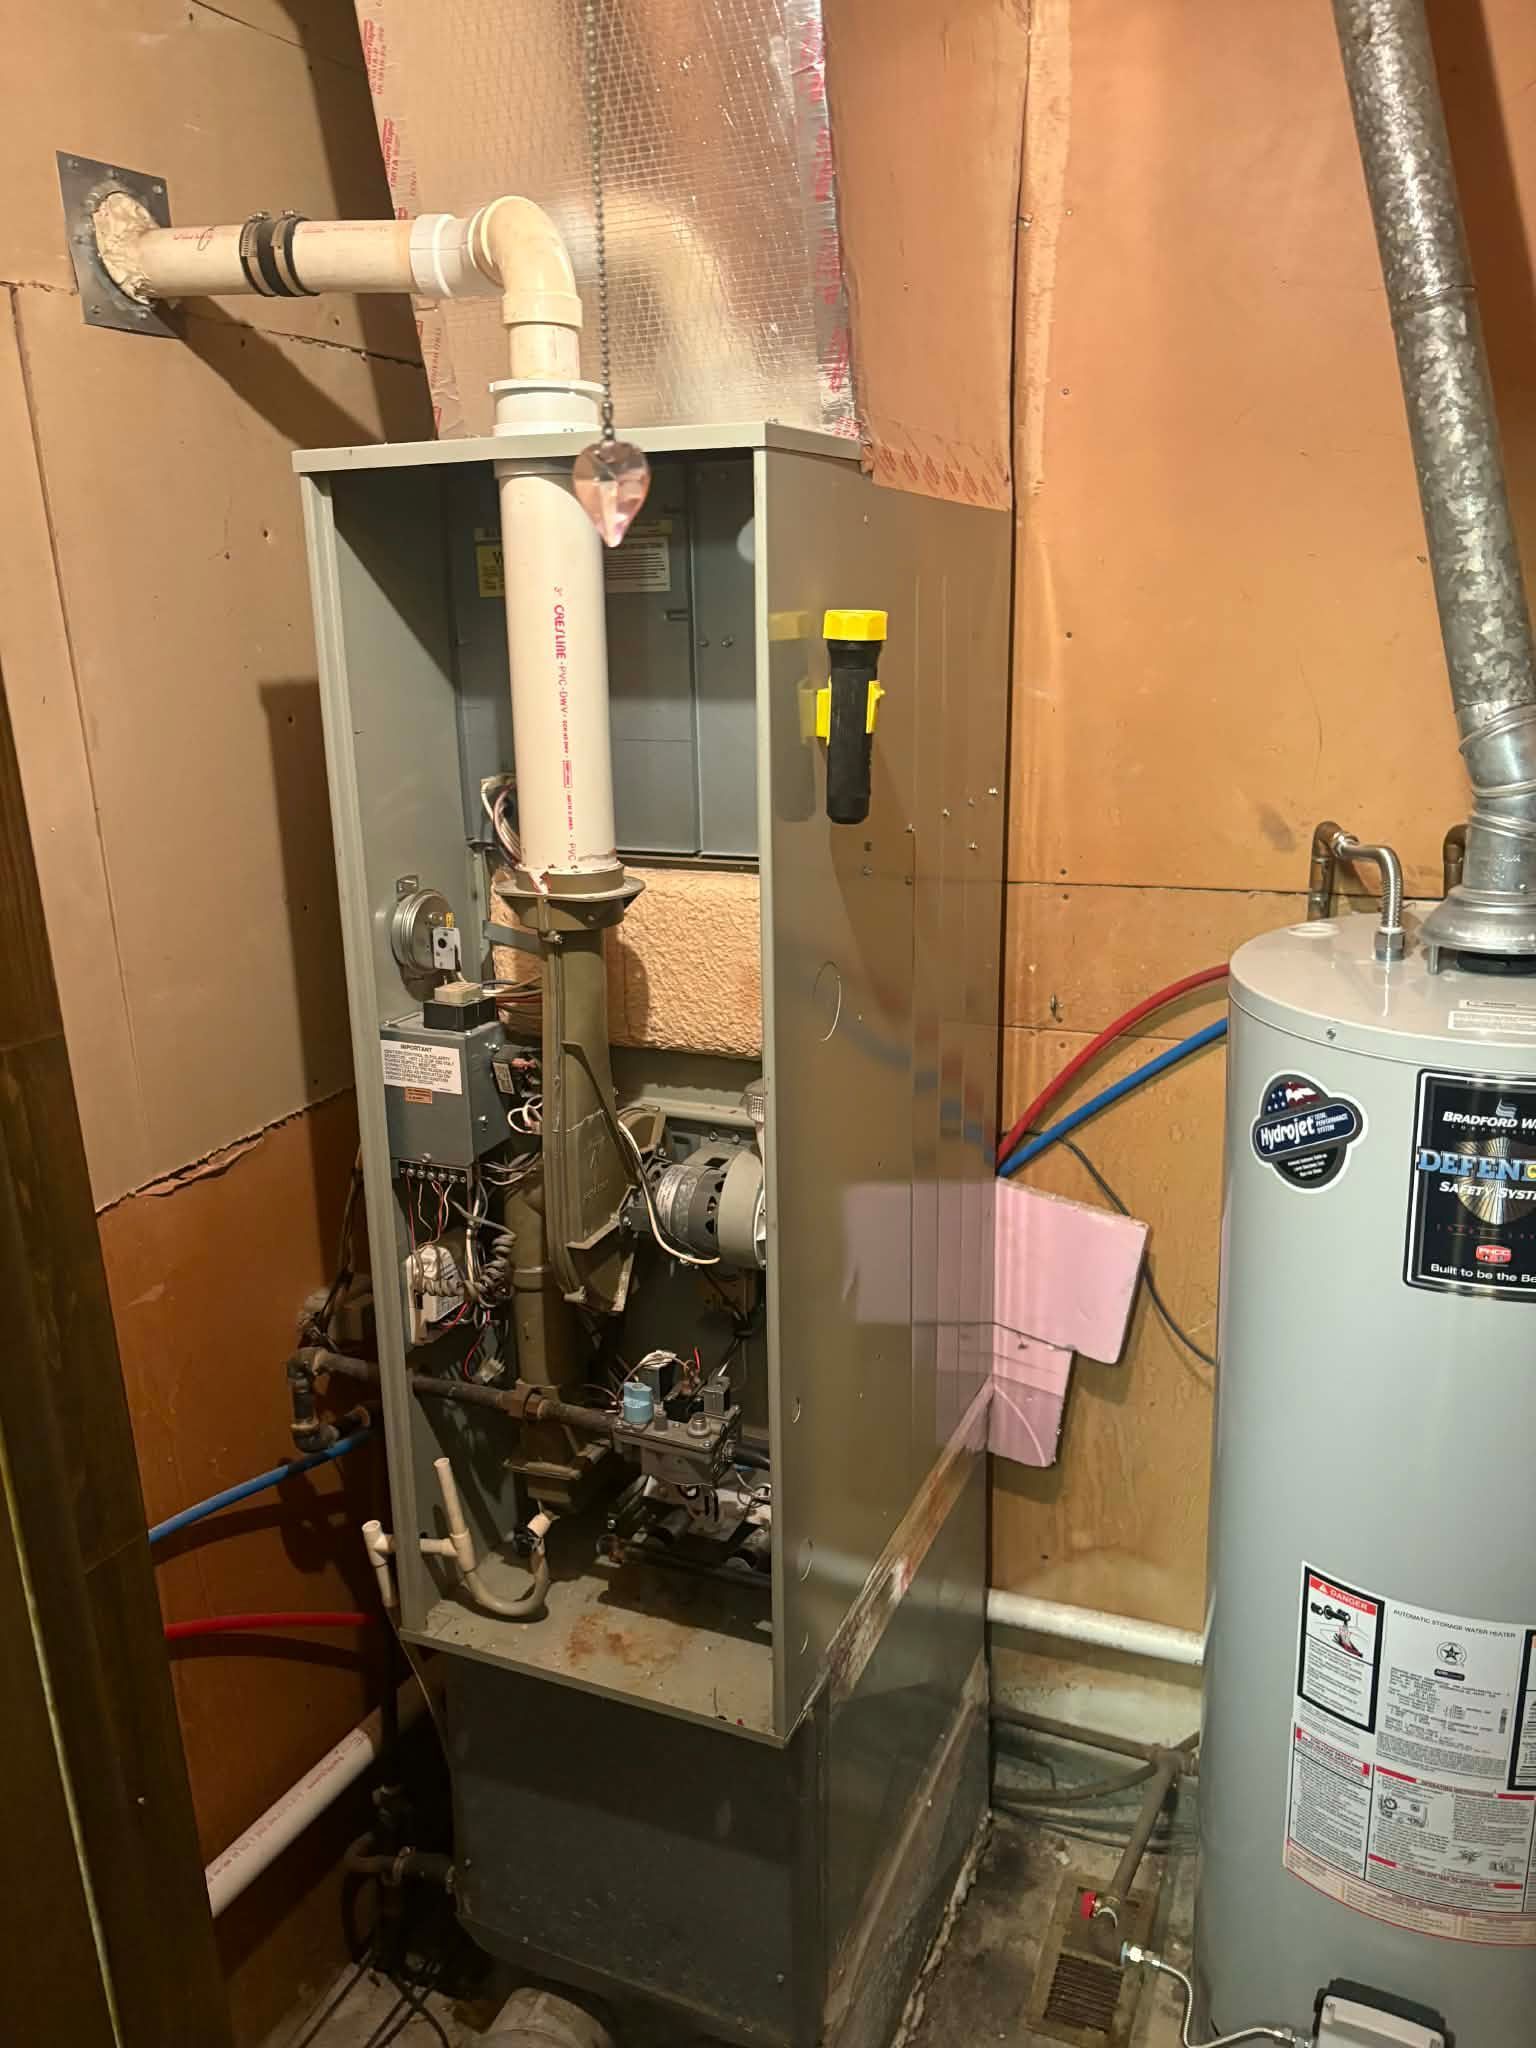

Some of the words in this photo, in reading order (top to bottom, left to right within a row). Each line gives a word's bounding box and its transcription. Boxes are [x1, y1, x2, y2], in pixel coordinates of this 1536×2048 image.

[1443, 1111, 1518, 1128] BRADFORD
[1260, 1115, 1315, 1150] Hydrojet
[1439, 1181, 1495, 1197] SAFETY
[1430, 1263, 1458, 1275] Built
[1461, 1268, 1474, 1278] to
[1477, 1270, 1493, 1280] be
[1497, 1272, 1518, 1282] the
[1329, 1590, 1368, 1611] DANGER
[1393, 1609, 1431, 1624] AUTOMATIC
[1432, 1619, 1463, 1631] STORAGE
[1464, 1626, 1489, 1636] WATER
[1489, 1631, 1516, 1639] HEATER
